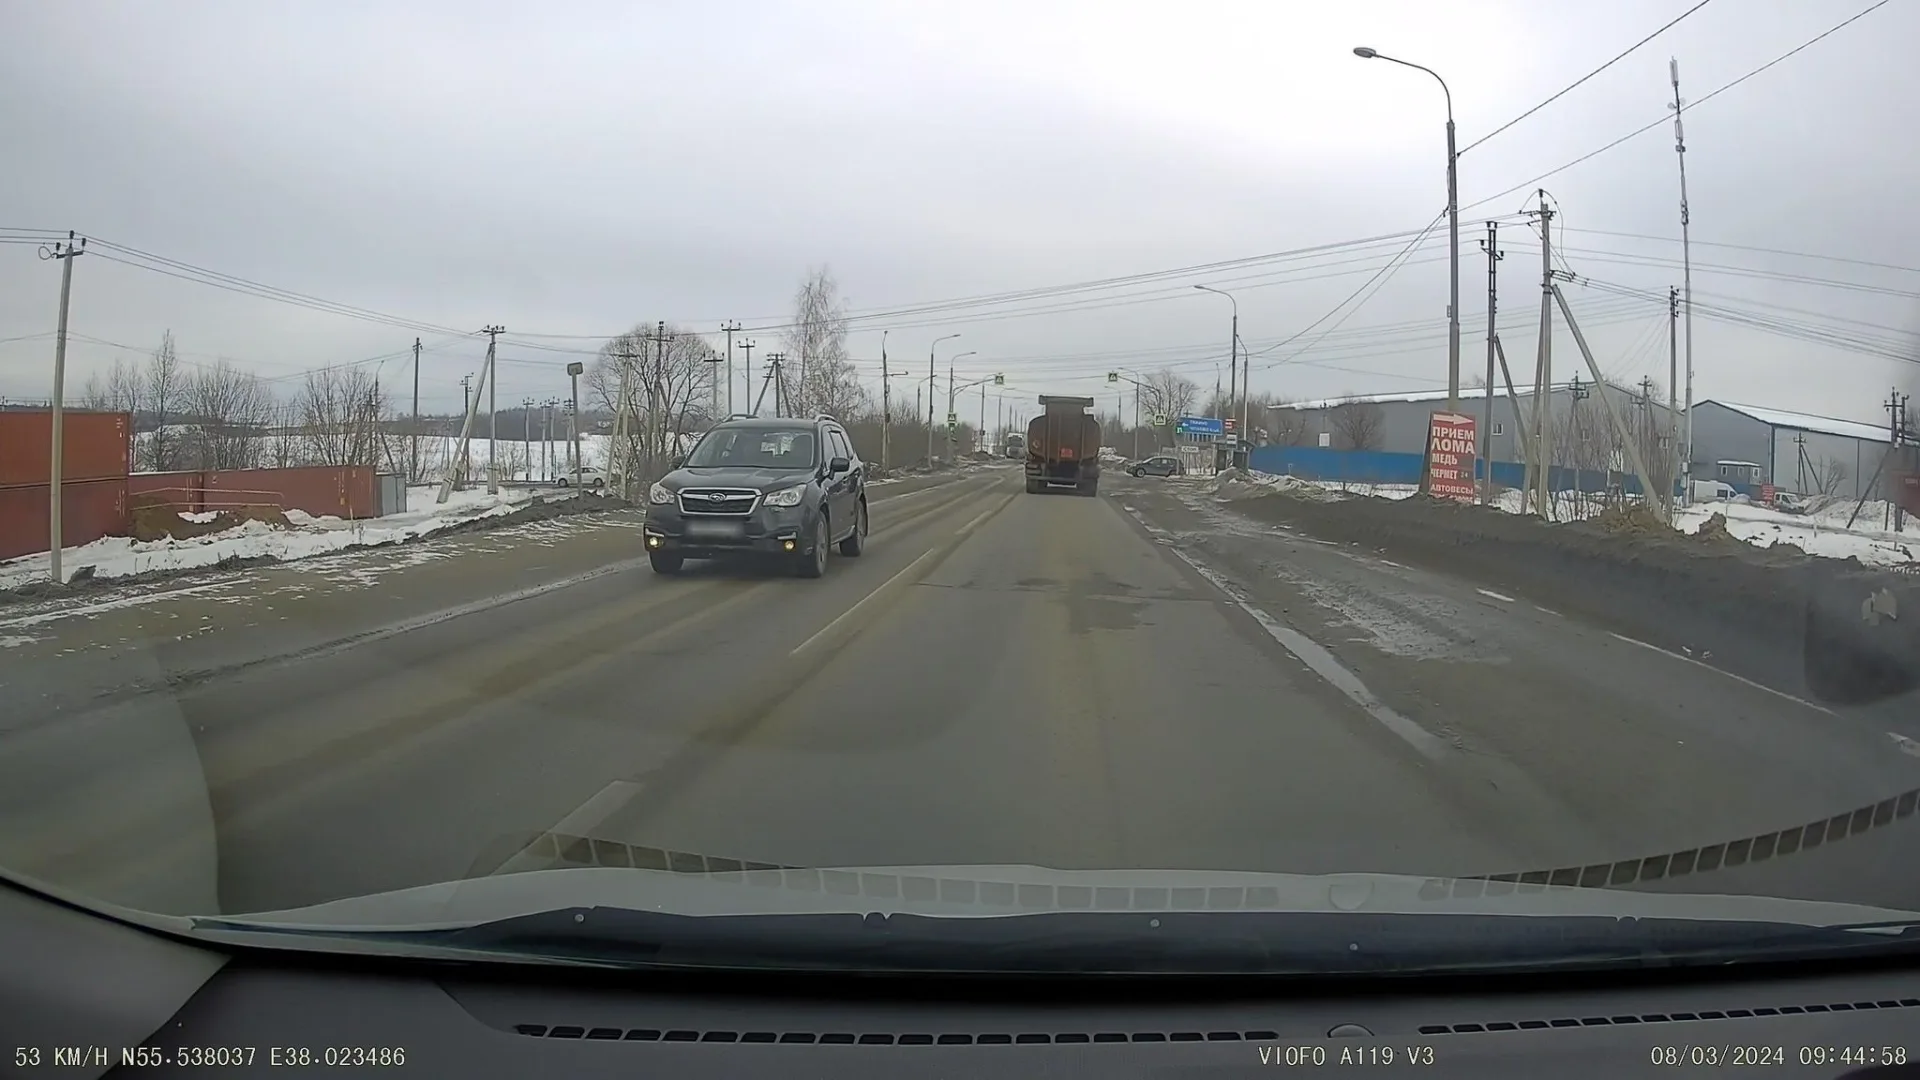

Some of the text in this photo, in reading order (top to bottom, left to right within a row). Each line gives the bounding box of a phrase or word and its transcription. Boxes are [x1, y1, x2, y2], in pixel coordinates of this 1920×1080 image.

[1432, 426, 1475, 441] ПРИЕМ
[1431, 437, 1476, 455] ЛОМА
[1431, 453, 1458, 466] МЕДЬ
[1430, 468, 1458, 480] ЧЕРМЕТ
[1430, 483, 1474, 495] АВТОВЕСЫ
